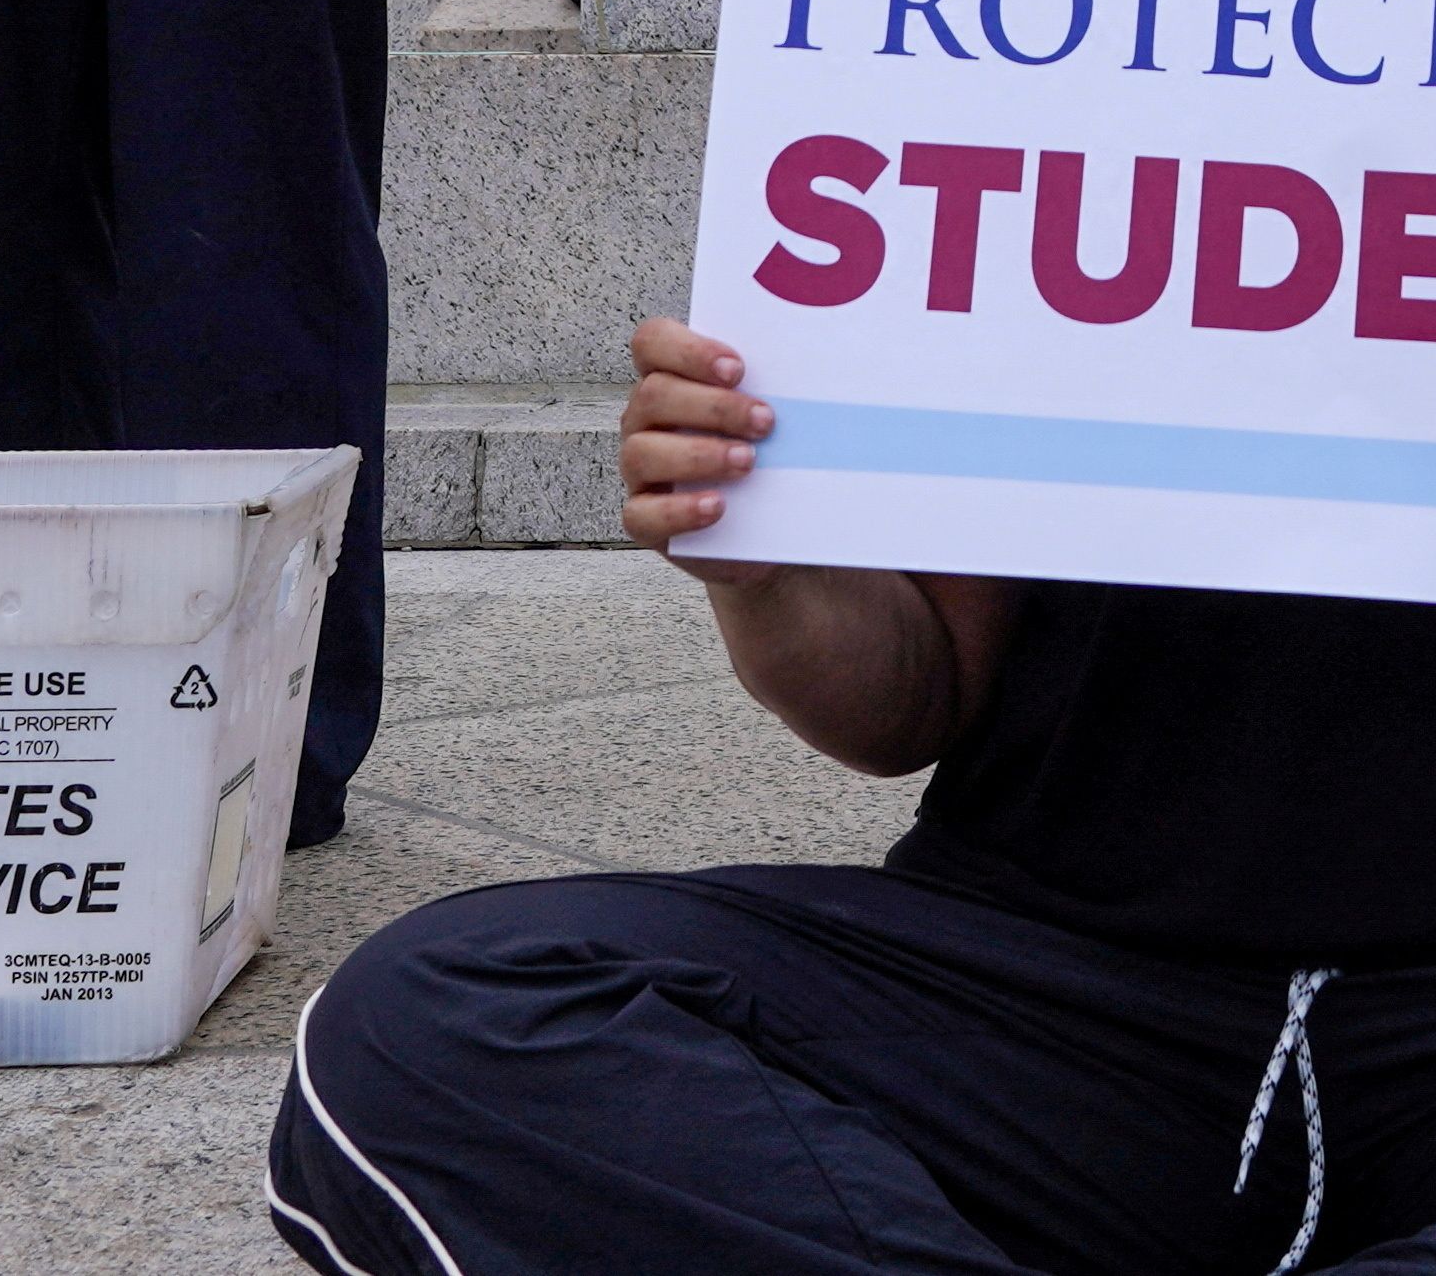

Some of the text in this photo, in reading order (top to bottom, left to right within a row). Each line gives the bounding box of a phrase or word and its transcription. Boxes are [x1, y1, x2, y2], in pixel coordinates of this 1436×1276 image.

[24, 672, 86, 697] USE
[14, 715, 114, 732] PROPERTY
[15, 740, 60, 760] 1707)
[11, 971, 49, 985] PSIN
[40, 987, 114, 1001] JAN 2013
